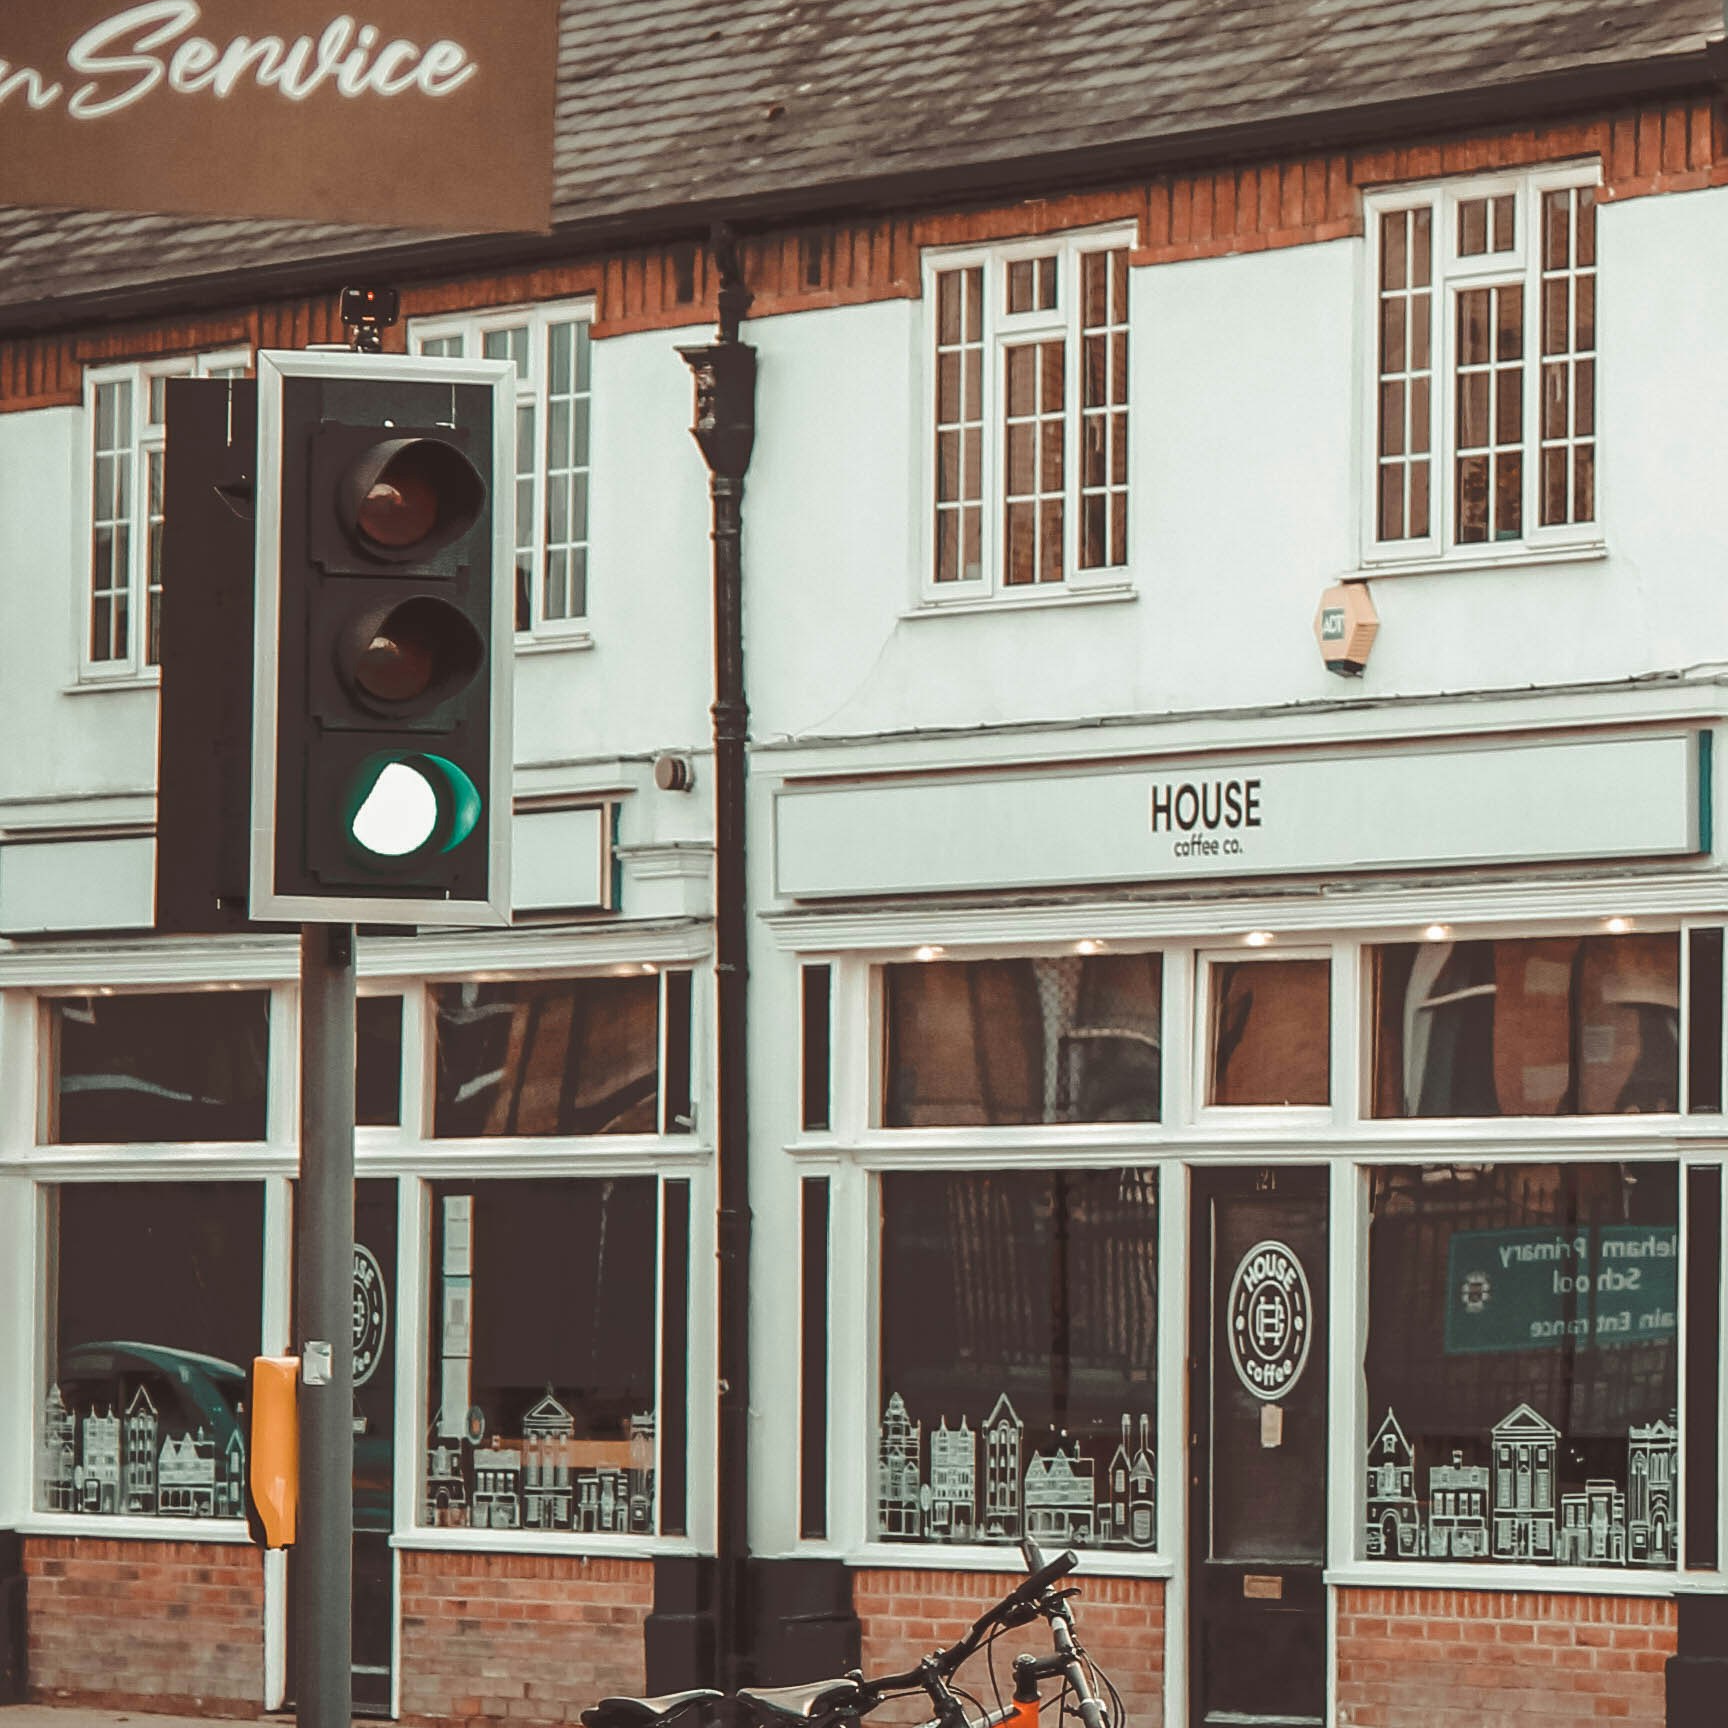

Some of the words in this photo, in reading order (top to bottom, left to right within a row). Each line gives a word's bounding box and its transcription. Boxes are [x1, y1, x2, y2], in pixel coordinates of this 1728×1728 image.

[1151, 779, 1262, 832] HOUSE
[1173, 832, 1220, 857] coffee
[1222, 838, 1244, 854] co.
[1242, 1253, 1298, 1293] HOUSE
[1245, 1358, 1294, 1387] coffee
